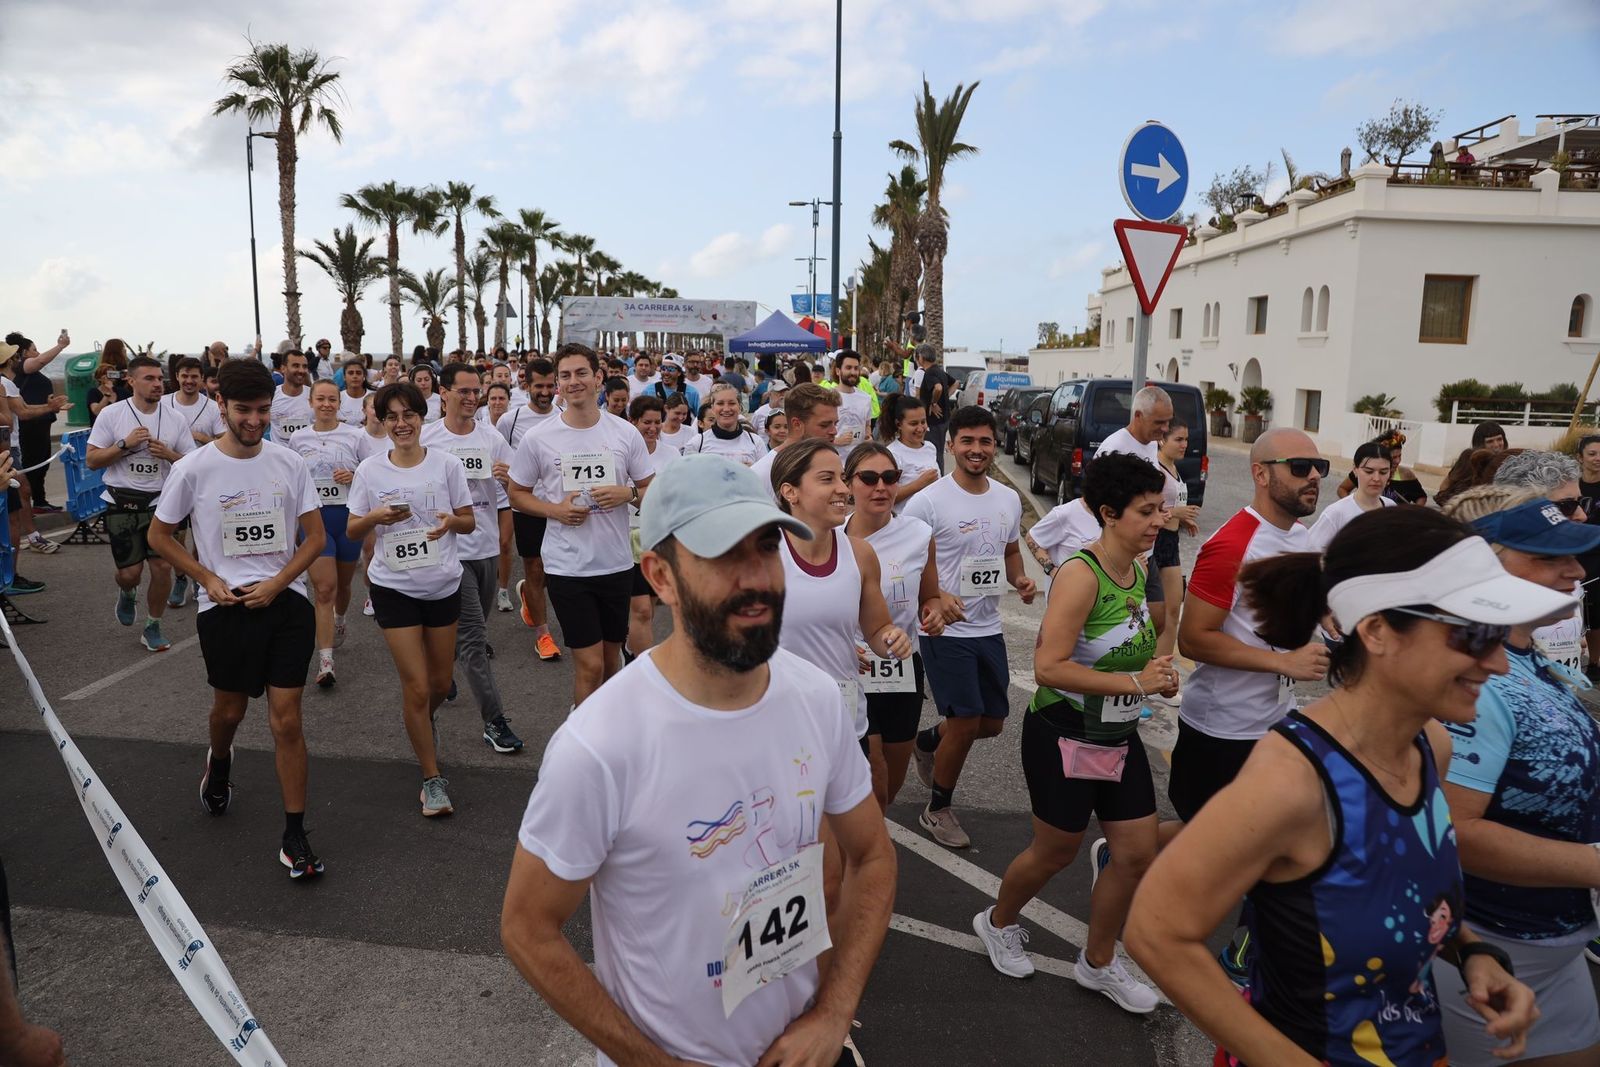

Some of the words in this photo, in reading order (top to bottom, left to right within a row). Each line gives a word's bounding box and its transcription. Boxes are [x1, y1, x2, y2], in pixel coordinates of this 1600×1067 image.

[637, 303, 681, 312] CARRERA
[682, 304, 694, 312] 5K
[129, 463, 159, 474] 1035
[571, 465, 606, 480] 713
[235, 523, 276, 542] 595
[395, 540, 429, 559] 851
[971, 569, 1000, 585] 627
[870, 659, 904, 678] 151
[738, 895, 809, 961] 142
